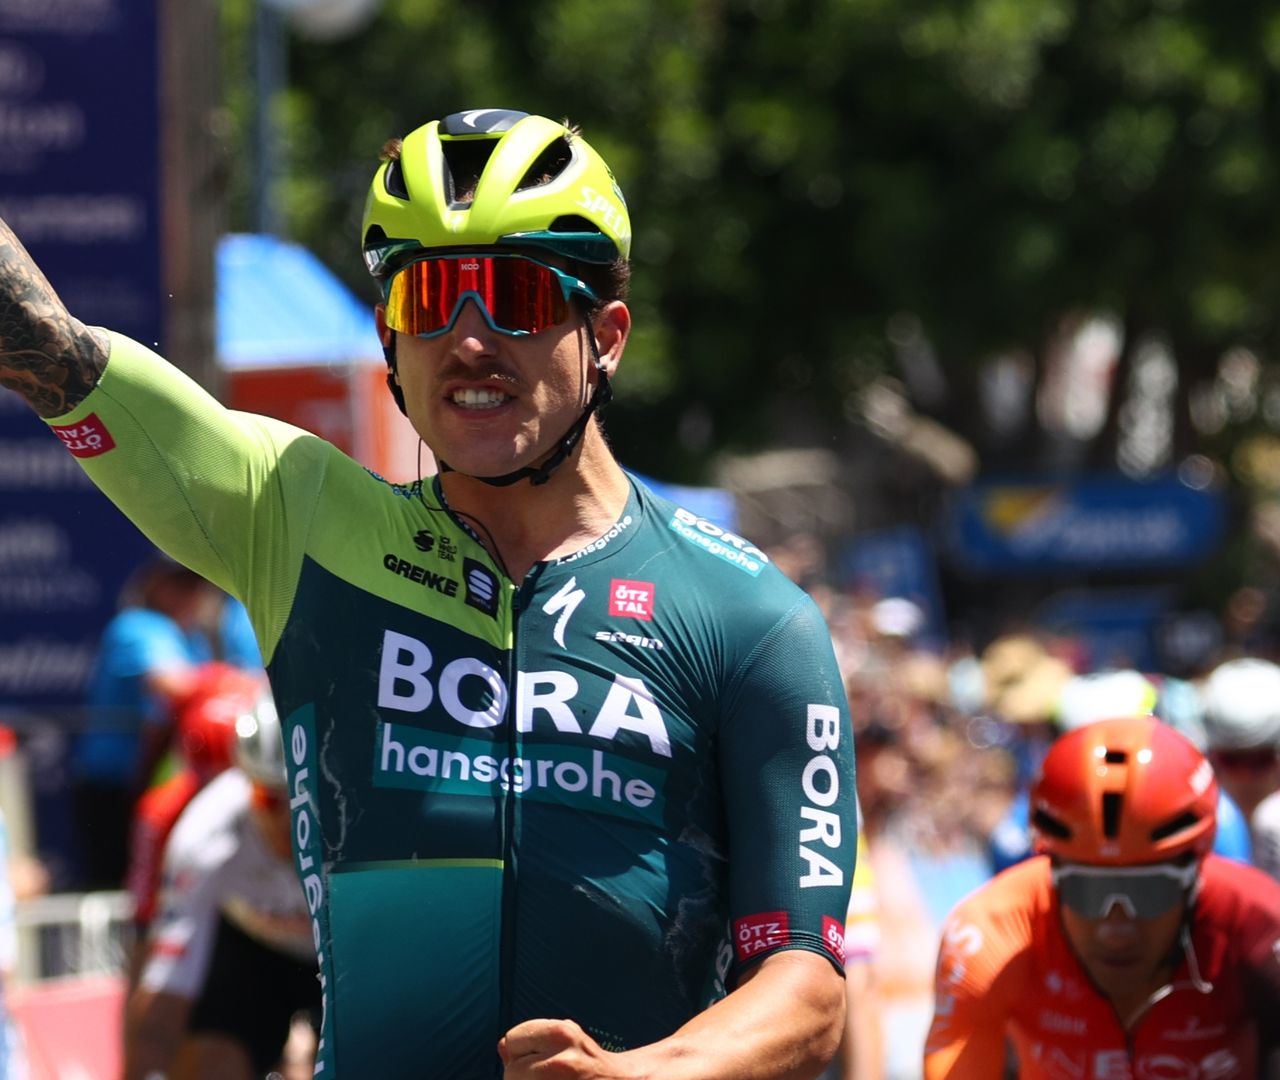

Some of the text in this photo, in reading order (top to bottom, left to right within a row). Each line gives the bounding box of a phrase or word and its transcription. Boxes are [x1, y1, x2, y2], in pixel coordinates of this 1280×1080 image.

[671, 520, 761, 572] hansgrohe
[674, 507, 769, 564] BORA
[383, 553, 459, 598] GRENKE
[615, 585, 649, 602] ÖTZ
[615, 601, 647, 615] TAL
[377, 628, 672, 758] BORA
[380, 722, 656, 808] hansgrohe
[799, 703, 844, 889] BORA
[738, 922, 781, 942] ÖTZ
[741, 936, 782, 955] TAL
